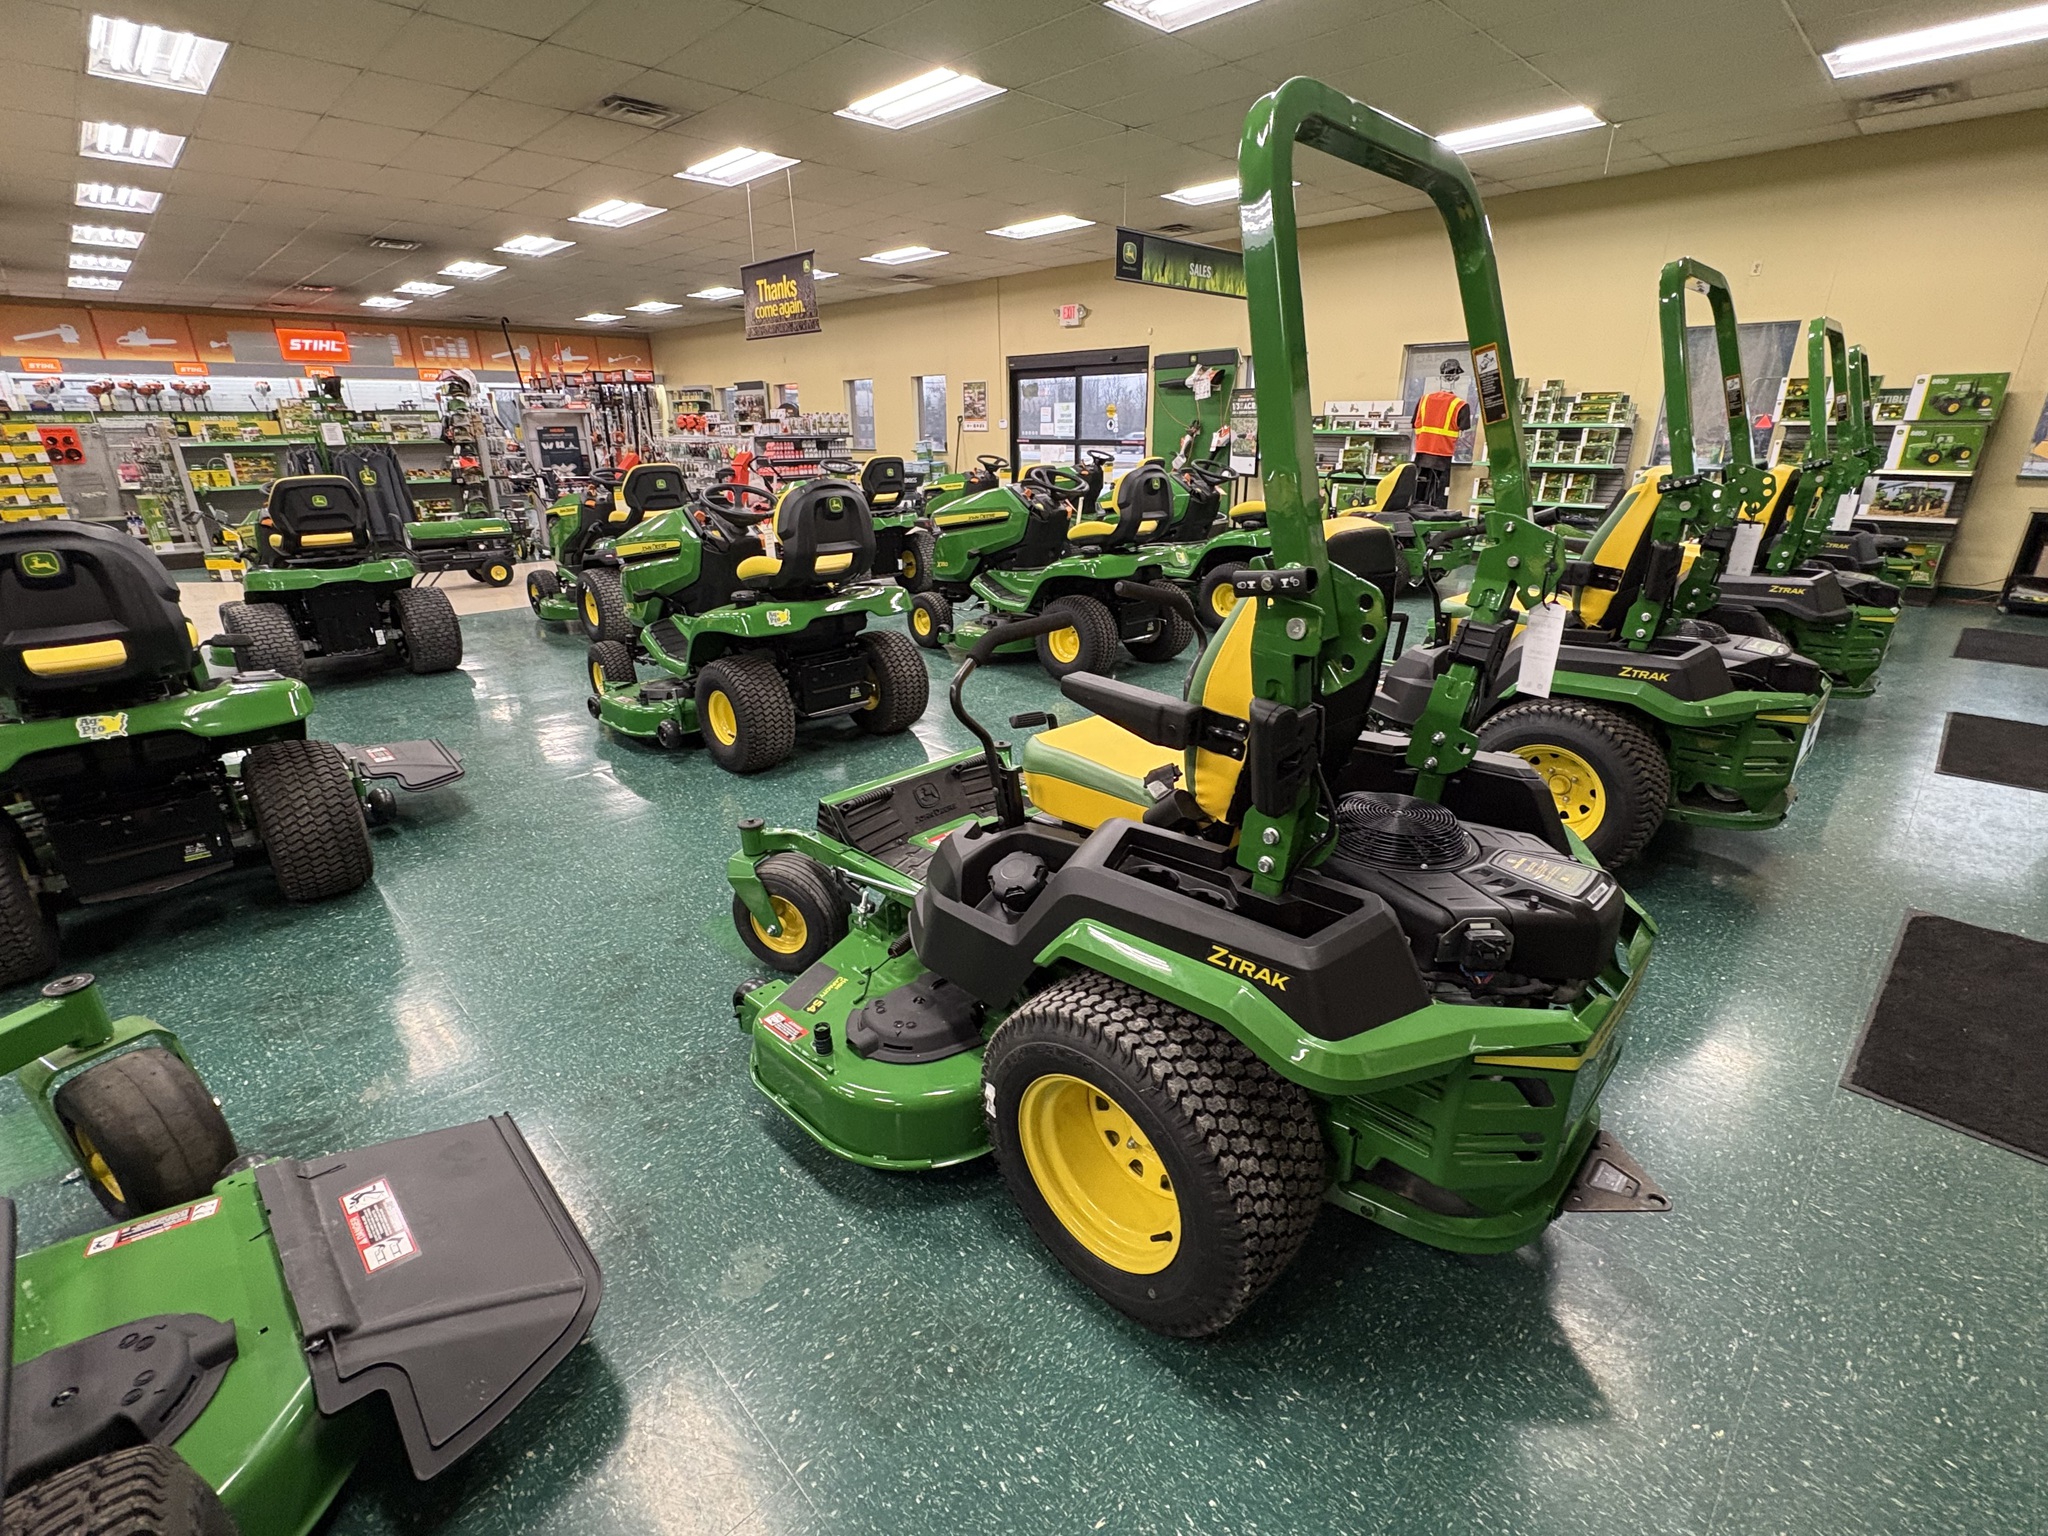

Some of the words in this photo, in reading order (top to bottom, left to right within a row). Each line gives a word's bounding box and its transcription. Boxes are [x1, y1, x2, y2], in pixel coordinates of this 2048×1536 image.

[1189, 262, 1212, 278] SALES
[756, 274, 798, 303] Thanks
[754, 303, 778, 319] come
[779, 297, 806, 318] again.
[1062, 305, 1076, 320] EXIT
[289, 338, 342, 352] STIHL
[1768, 584, 1807, 596] ZTRAK
[1618, 665, 1671, 682] ZTRAK
[82, 726, 105, 735] Pro
[1206, 944, 1291, 992] ZTRAK
[806, 999, 824, 1013] 54
